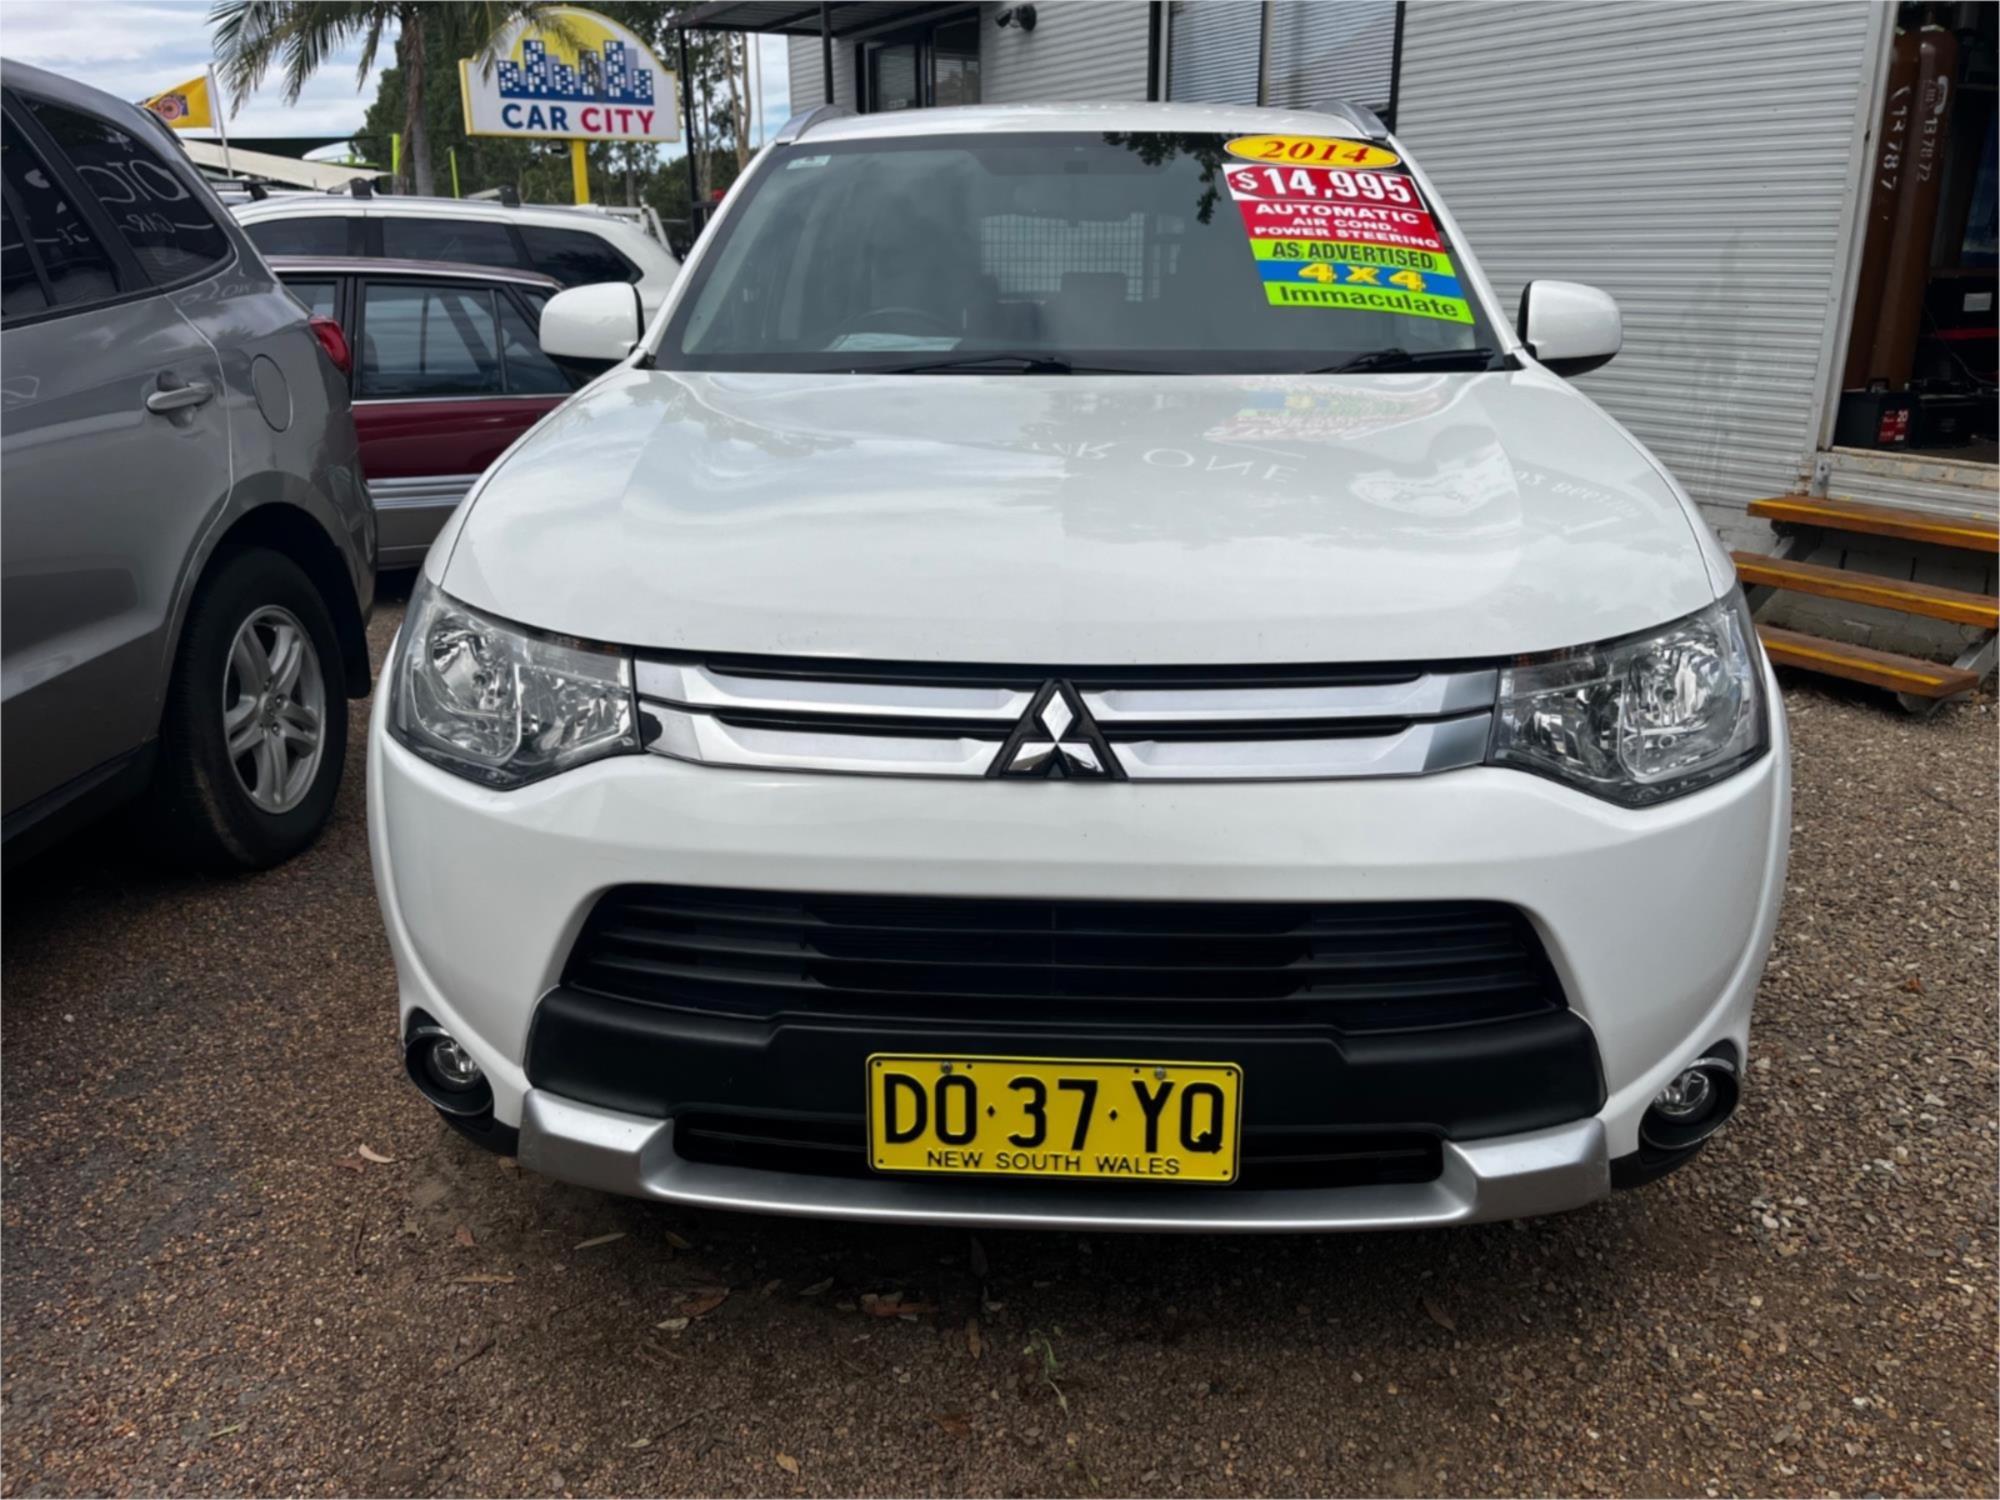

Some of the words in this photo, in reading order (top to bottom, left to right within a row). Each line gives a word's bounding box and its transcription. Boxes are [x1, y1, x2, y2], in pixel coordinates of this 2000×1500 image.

[502, 104, 569, 131] CAR
[580, 107, 655, 134] CITY
[1262, 142, 1367, 165] 2014
[1255, 203, 1420, 226] AUTOMATIC
[1292, 216, 1328, 228] AIR
[1333, 219, 1398, 233] COND.
[1254, 226, 1332, 238] POWER
[1337, 230, 1440, 249] STEERING
[1272, 241, 1300, 259] AS
[1309, 244, 1435, 270] ADVERTISED
[1280, 286, 1459, 319] Immaculate
[927, 1150, 984, 1168] NEW
[995, 1152, 1081, 1172] SOUTH
[1095, 1155, 1180, 1176] WALES
